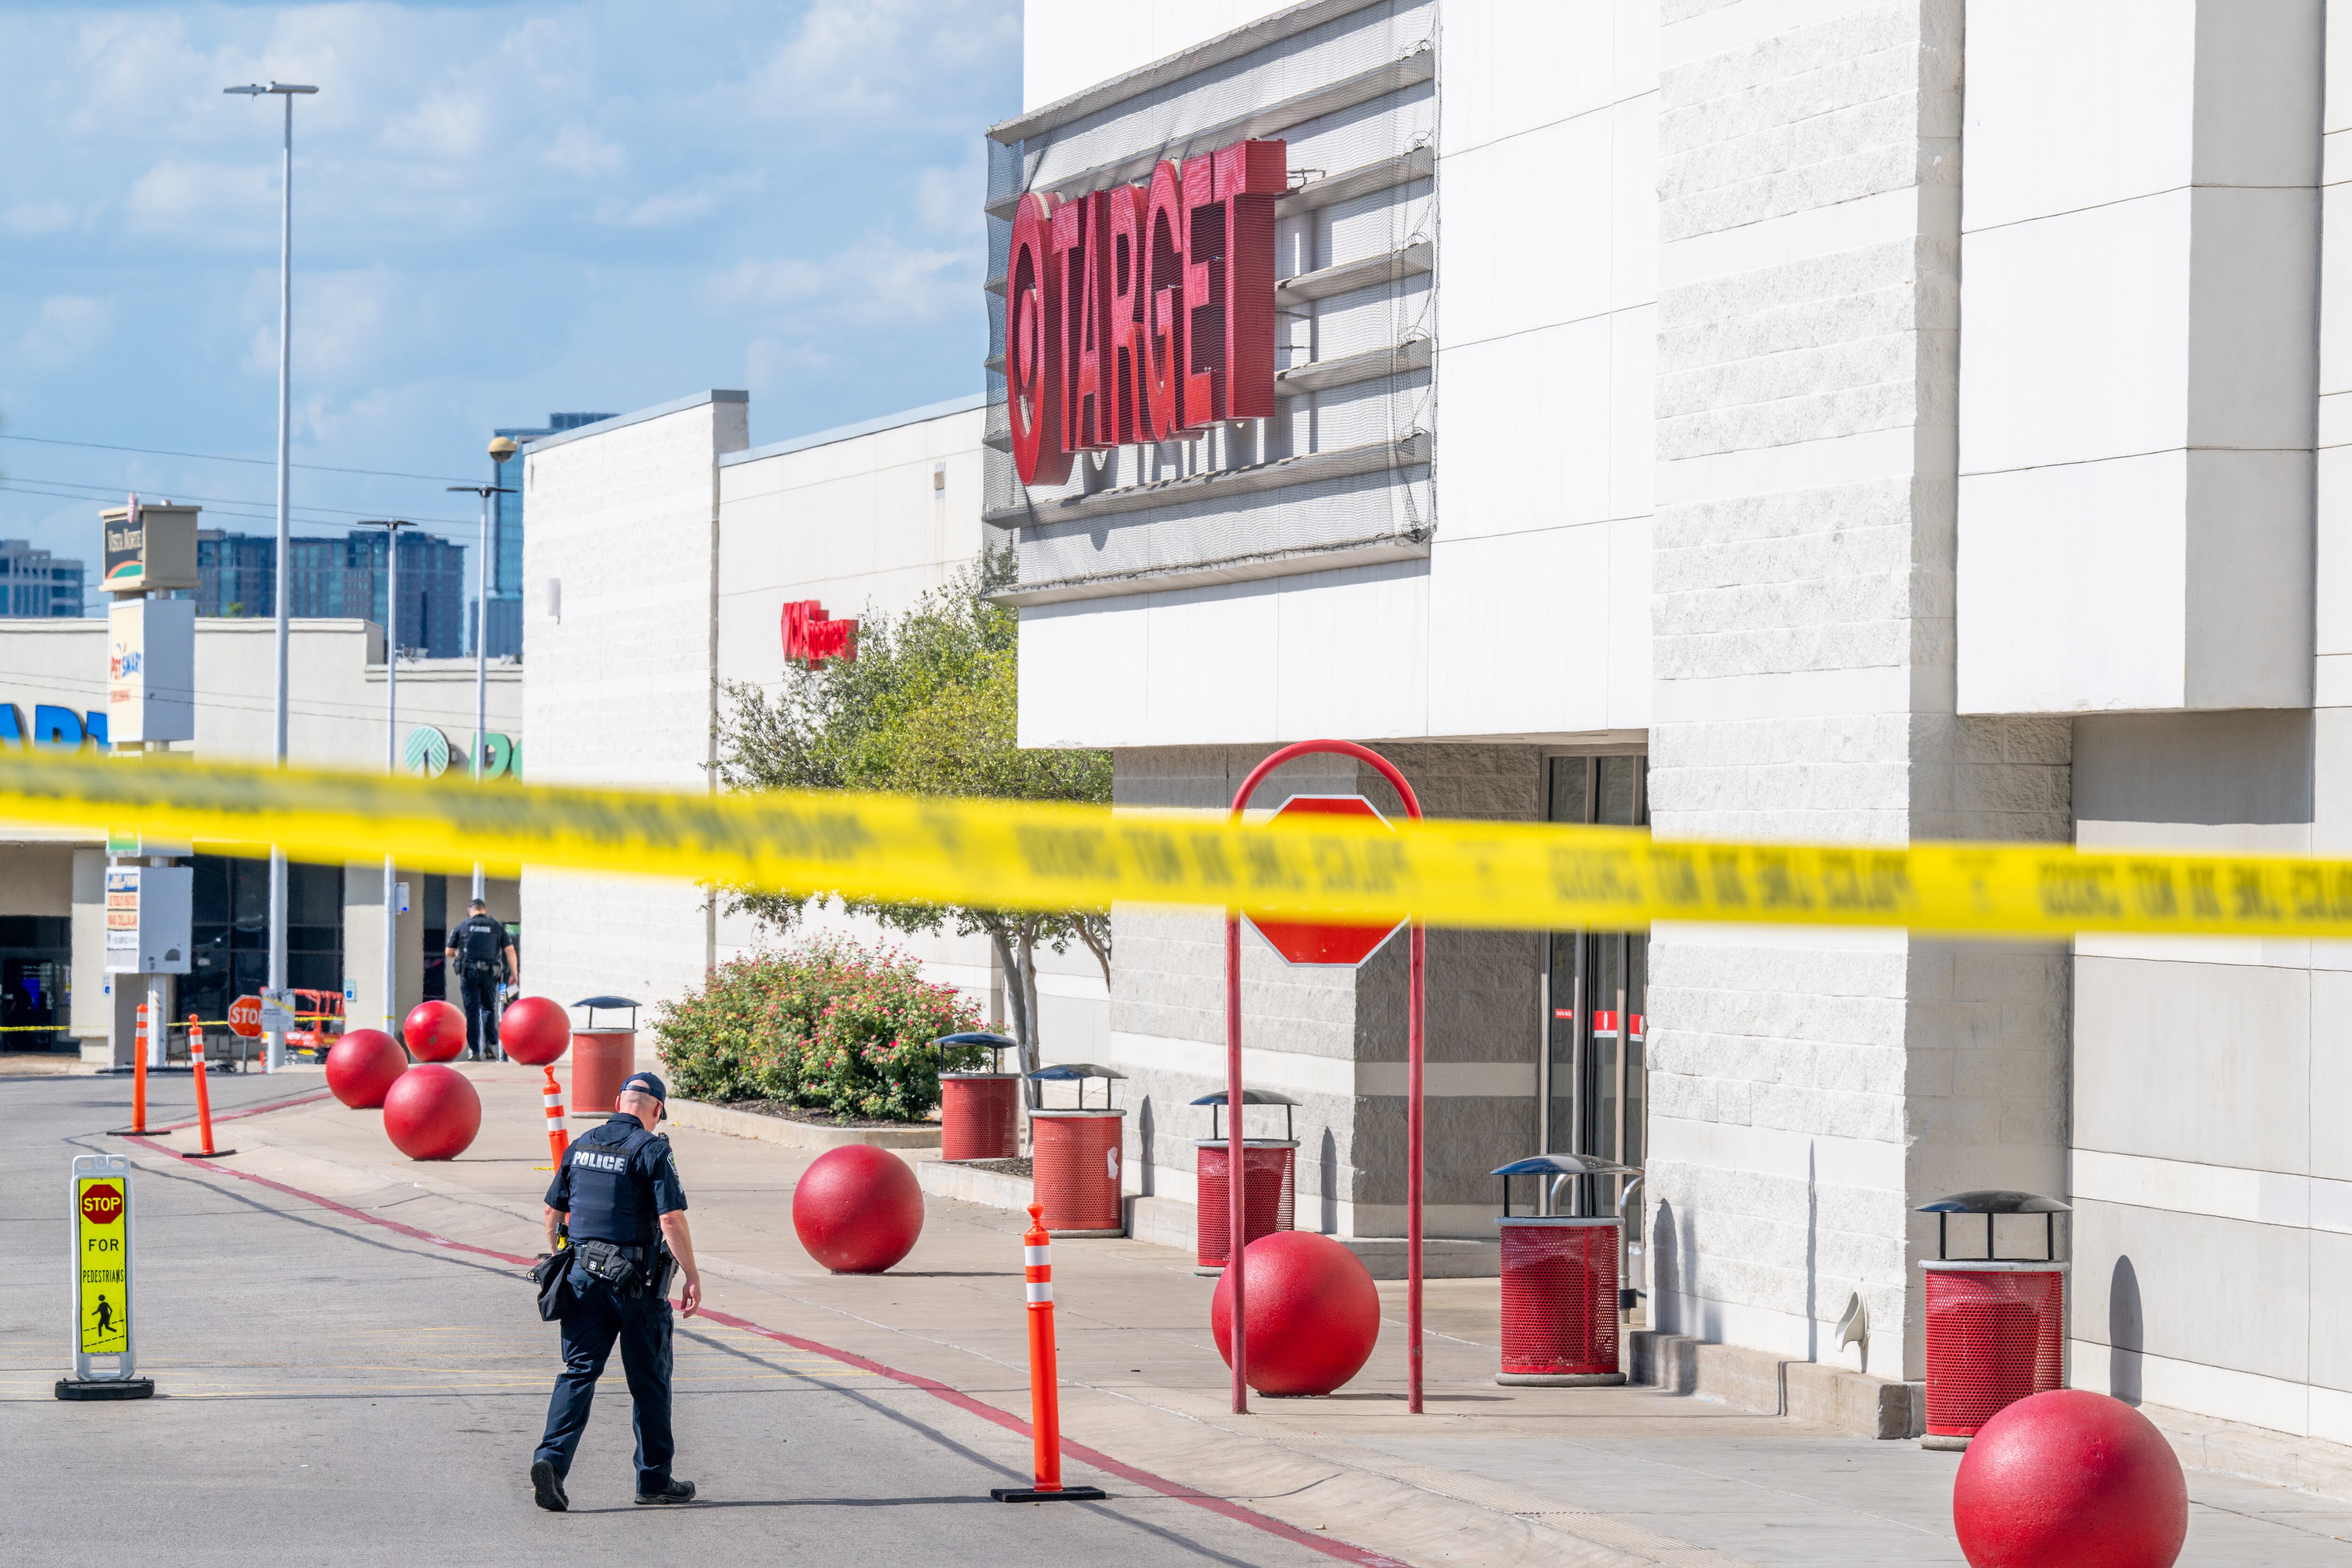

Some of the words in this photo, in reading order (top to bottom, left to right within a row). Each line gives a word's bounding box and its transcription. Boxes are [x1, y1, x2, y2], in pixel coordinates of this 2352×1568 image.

[1051, 140, 1287, 453] TARGET
[572, 1151, 625, 1172] POLICE
[84, 1197, 120, 1211] STOP
[88, 1239, 119, 1251] FOR
[83, 1269, 124, 1283] PEDESTRIANS
